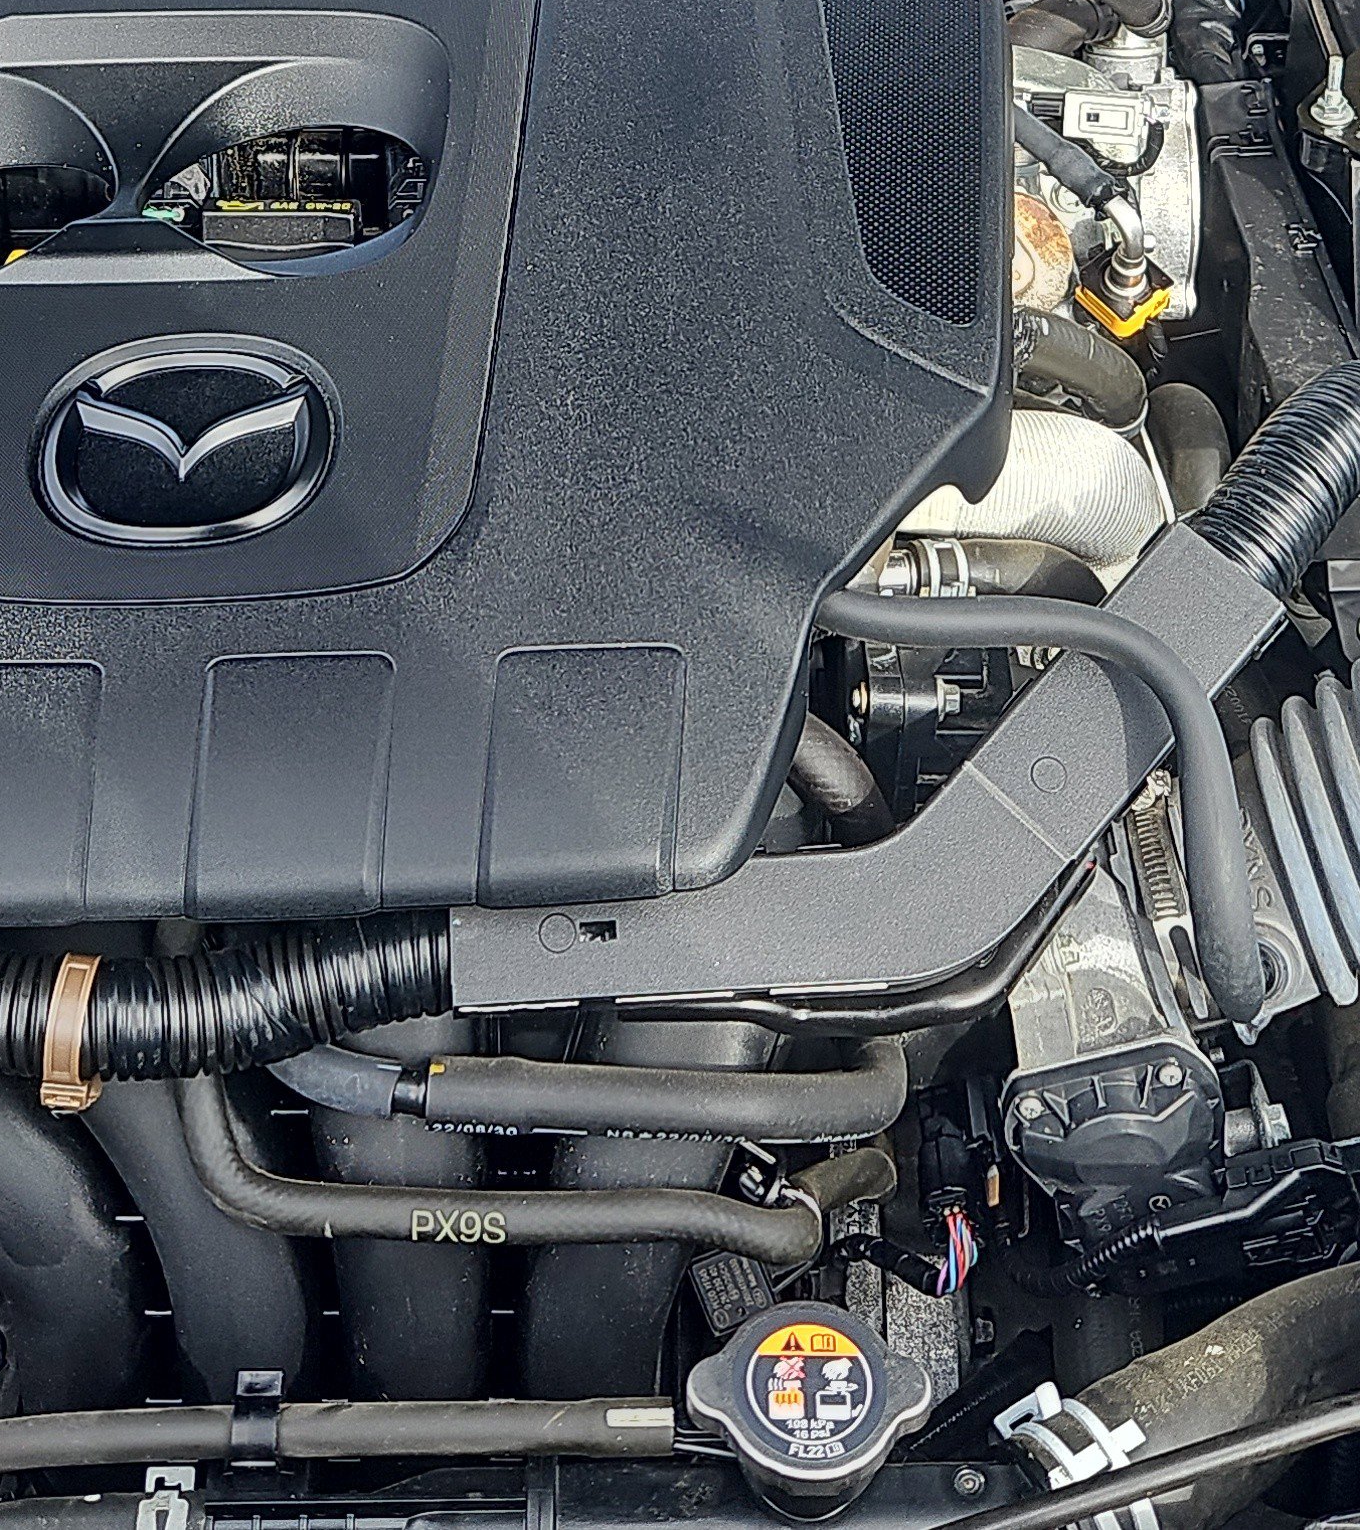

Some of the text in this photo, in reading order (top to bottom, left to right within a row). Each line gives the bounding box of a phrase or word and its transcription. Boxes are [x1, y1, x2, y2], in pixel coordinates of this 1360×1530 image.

[270, 201, 299, 210] SAE
[410, 1209, 507, 1244] PX9S
[810, 1418, 835, 1429] kPa
[810, 1429, 830, 1439] psi
[788, 1443, 825, 1458] FL22
